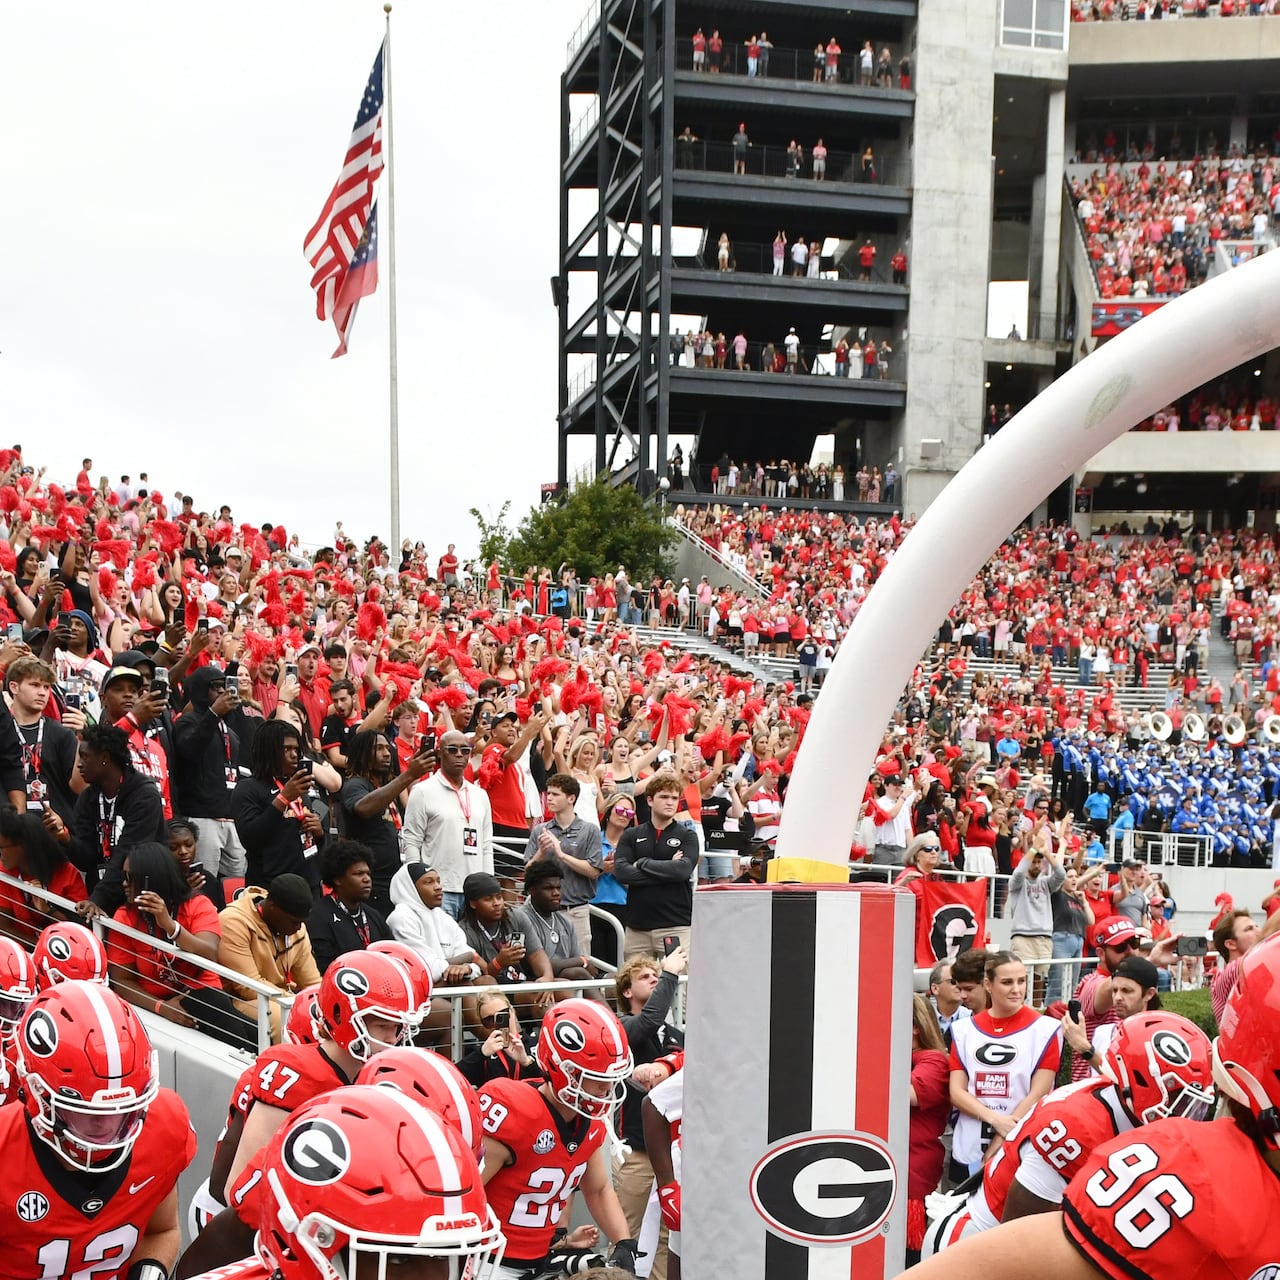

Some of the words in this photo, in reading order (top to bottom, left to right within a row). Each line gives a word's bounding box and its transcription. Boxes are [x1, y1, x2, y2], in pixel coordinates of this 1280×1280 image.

[545, 491, 553, 502] 2
[1108, 920, 1134, 935] UGA
[48, 935, 71, 961] G
[333, 967, 369, 998] G
[23, 1007, 58, 1060] G
[554, 1021, 585, 1052] G
[1153, 1032, 1190, 1065] G
[975, 1042, 1017, 1066] G
[258, 1060, 300, 1099] 47
[976, 1081, 1006, 1089] BUREAU
[986, 1074, 1006, 1082] FARM
[102, 1090, 132, 1102] DAWGS
[479, 1092, 509, 1134] 29
[283, 1119, 348, 1182] G
[1035, 1119, 1083, 1169] 22
[755, 1141, 894, 1236] G
[1085, 1143, 1194, 1249] 96
[18, 1194, 48, 1219] SEC
[435, 1218, 477, 1232] DAWGS
